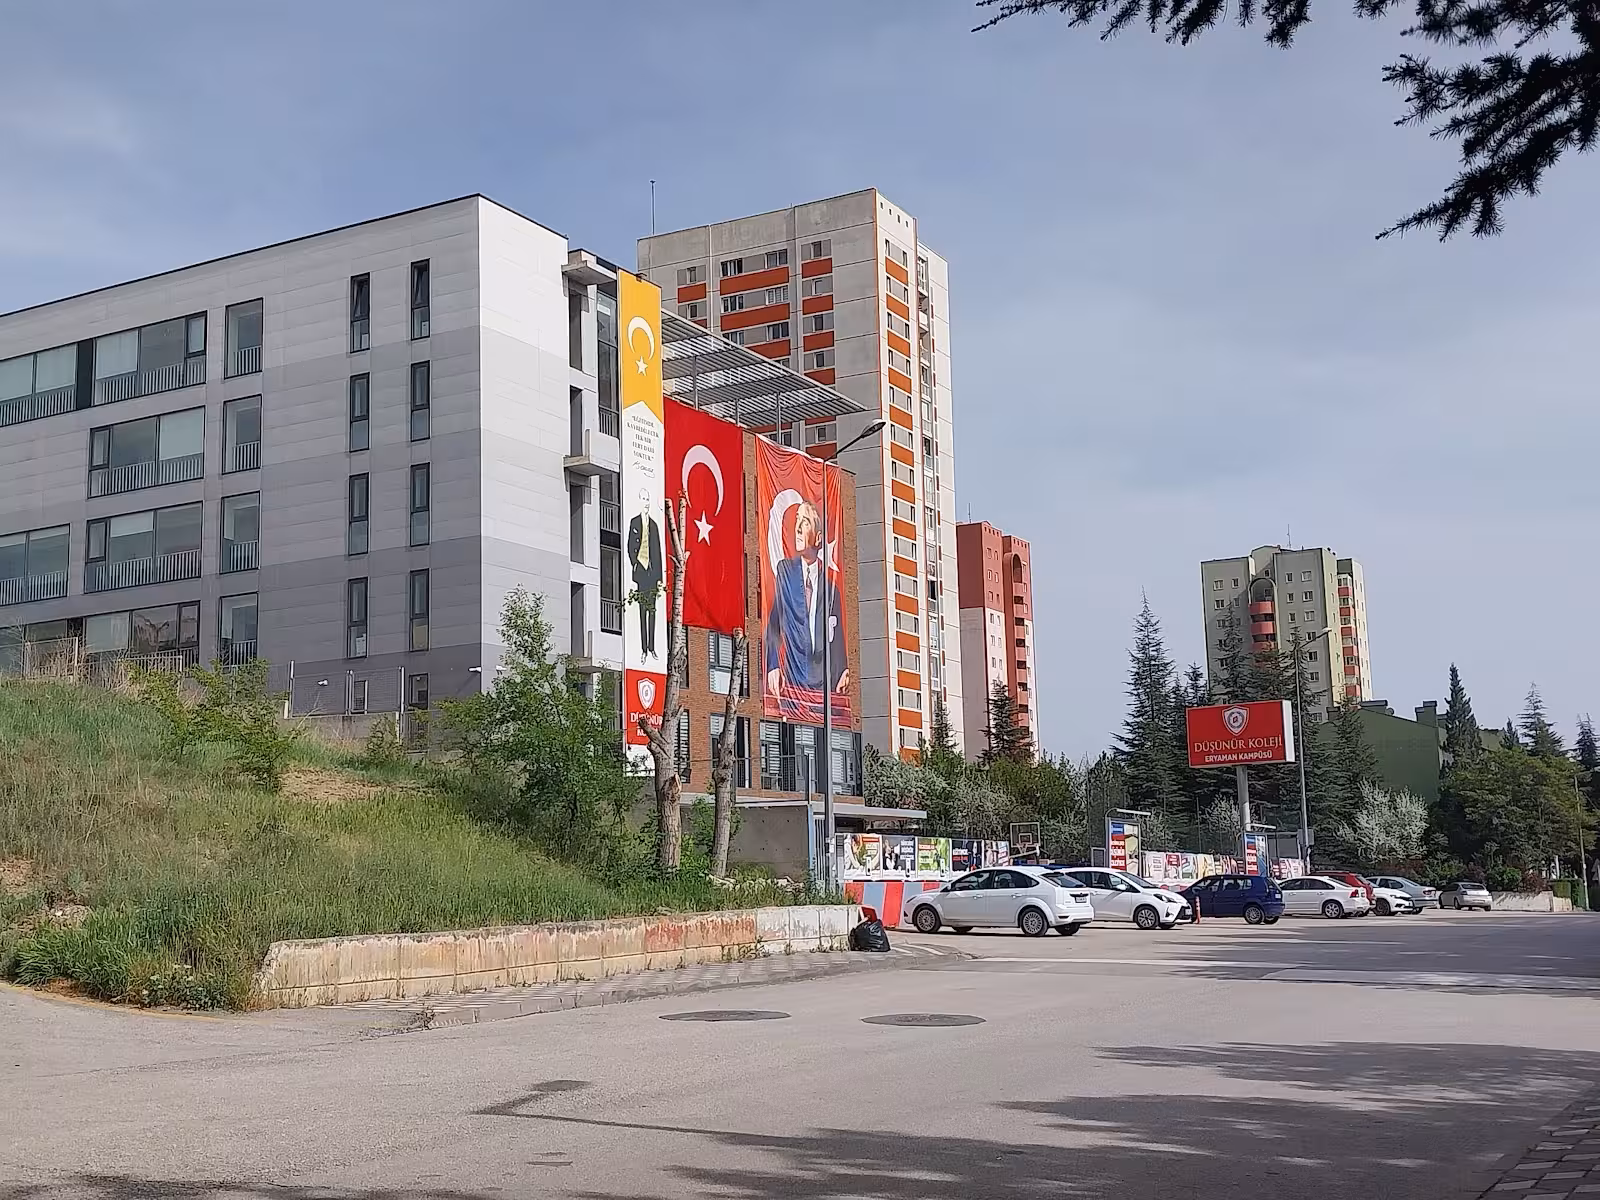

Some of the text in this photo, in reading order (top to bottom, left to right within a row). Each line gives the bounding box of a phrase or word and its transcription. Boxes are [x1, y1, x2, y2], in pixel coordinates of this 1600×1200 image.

[1194, 734, 1283, 753] DÜŞÜNÜR KOLEJİ
[1205, 750, 1272, 762] ERYAMAN KAMPÜSÜ
